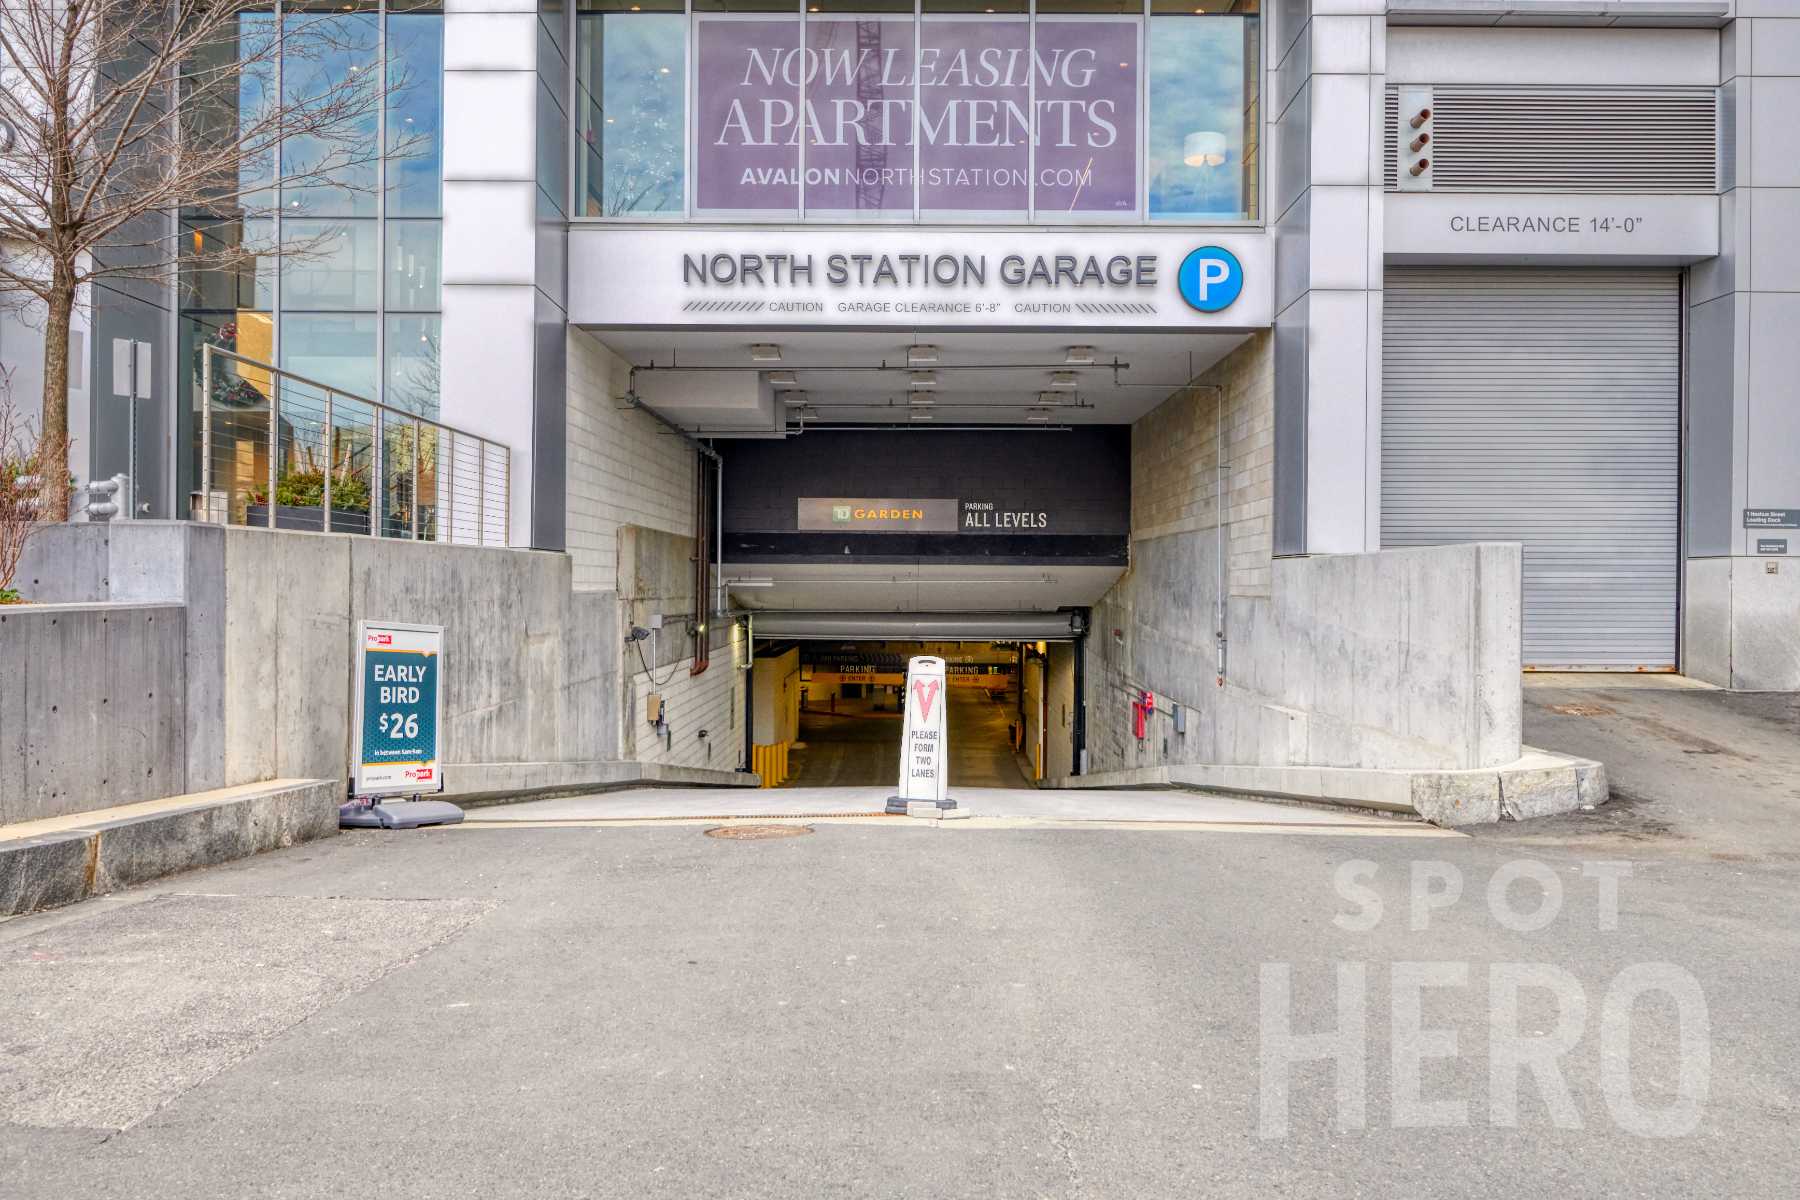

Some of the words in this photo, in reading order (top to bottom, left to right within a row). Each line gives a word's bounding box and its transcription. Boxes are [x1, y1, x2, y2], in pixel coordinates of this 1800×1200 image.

[740, 48, 873, 86] NOW
[877, 48, 1096, 87] LEASING
[714, 98, 1117, 147] APARTMENTS
[1450, 216, 1580, 232] CLEARANCE
[683, 253, 812, 284] NORTH
[826, 254, 986, 284] STATION
[1000, 254, 1158, 286] GARAGE
[1199, 258, 1230, 302] P
[769, 302, 823, 313] CAUTION
[838, 302, 891, 313] GARAGE
[895, 302, 972, 313] CLEARANCE
[1014, 303, 1071, 313] CAUTION
[854, 509, 923, 520] GARDEN
[965, 503, 993, 511] PARKING
[965, 512, 990, 528] ALL
[995, 512, 1047, 528] LEVELS
[374, 664, 427, 683] EARLY
[840, 665, 876, 673] PARKING
[380, 686, 420, 704] BIRD
[379, 712, 419, 738] $26
[911, 730, 938, 740] PLEASE
[914, 743, 934, 752] FORM
[915, 756, 932, 765] TWO
[911, 769, 935, 778] LANES
